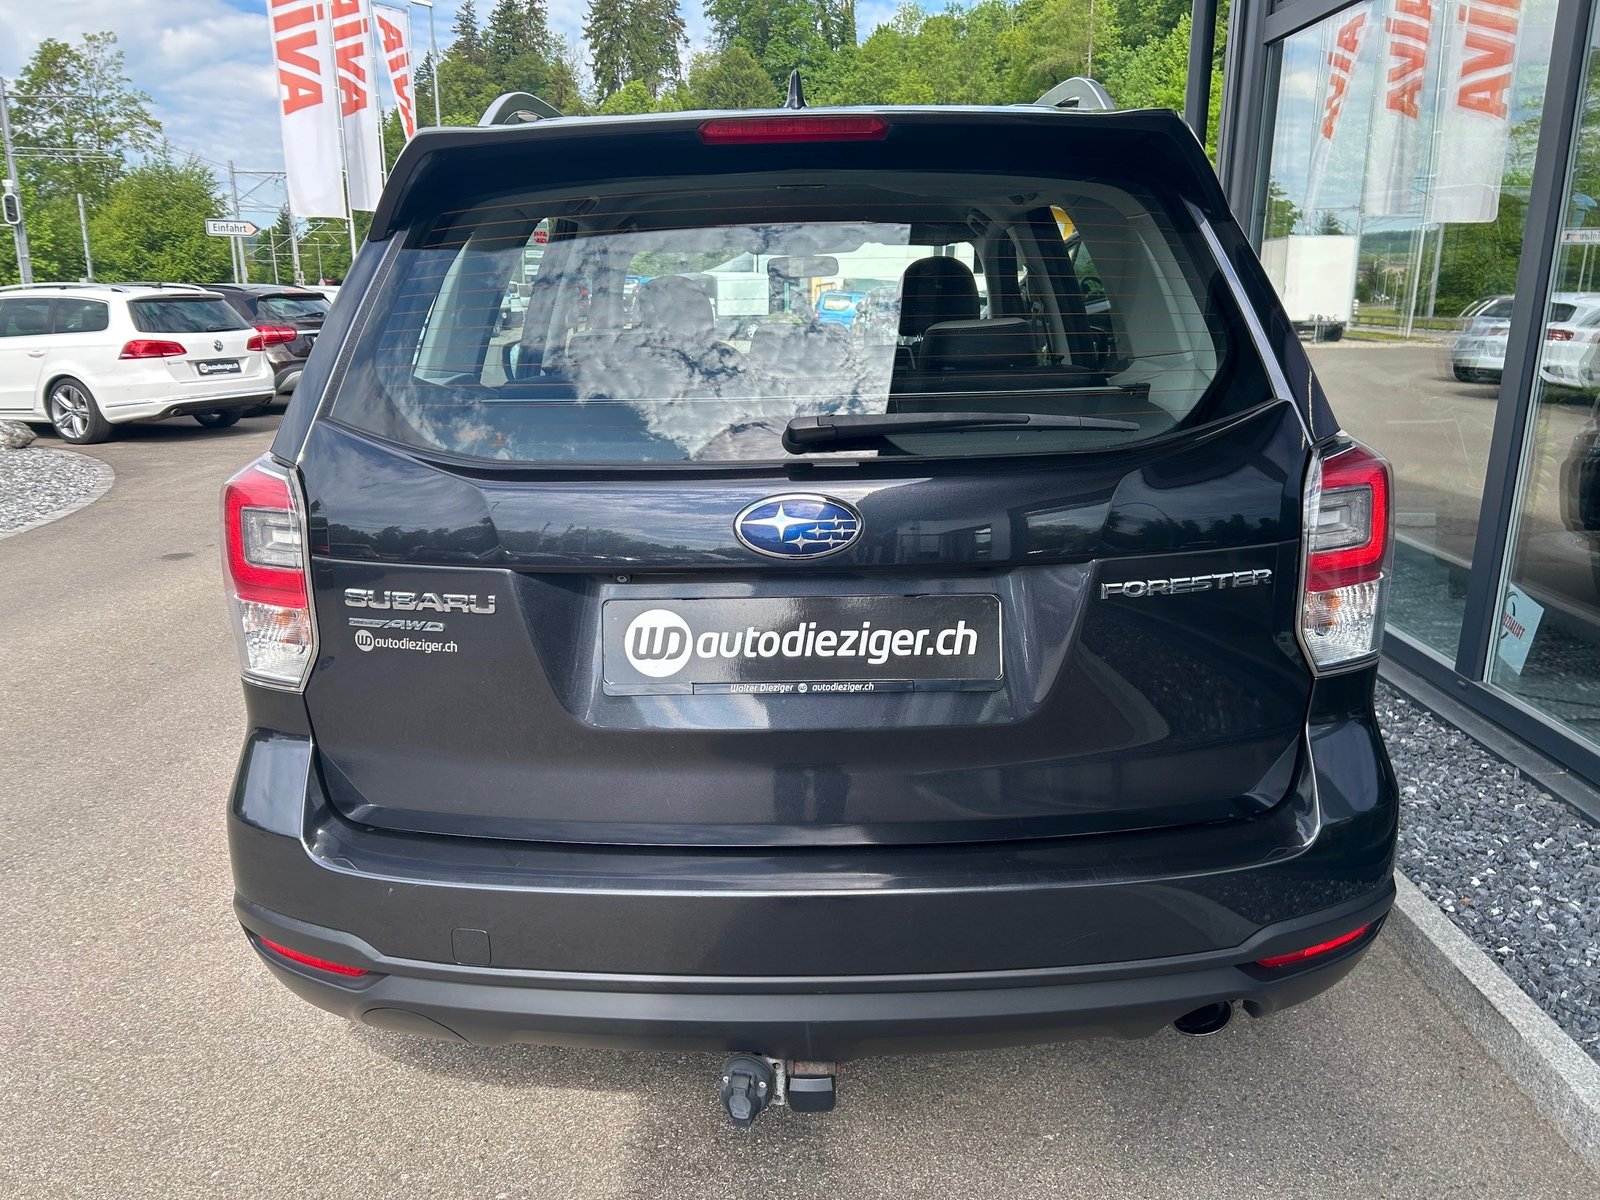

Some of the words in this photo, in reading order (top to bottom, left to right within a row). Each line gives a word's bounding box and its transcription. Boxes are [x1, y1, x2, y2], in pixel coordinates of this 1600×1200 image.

[212, 222, 247, 232] Einfahrt
[1101, 568, 1273, 600] FORESTER
[344, 588, 497, 614] SUBARU
[383, 619, 446, 632] AWD
[374, 637, 458, 653] autodieziger.ch
[696, 620, 978, 664] autodieziger.ch
[730, 684, 758, 693] Walter
[759, 683, 794, 694] Dieziger
[812, 682, 875, 693] autodieziger.ch
